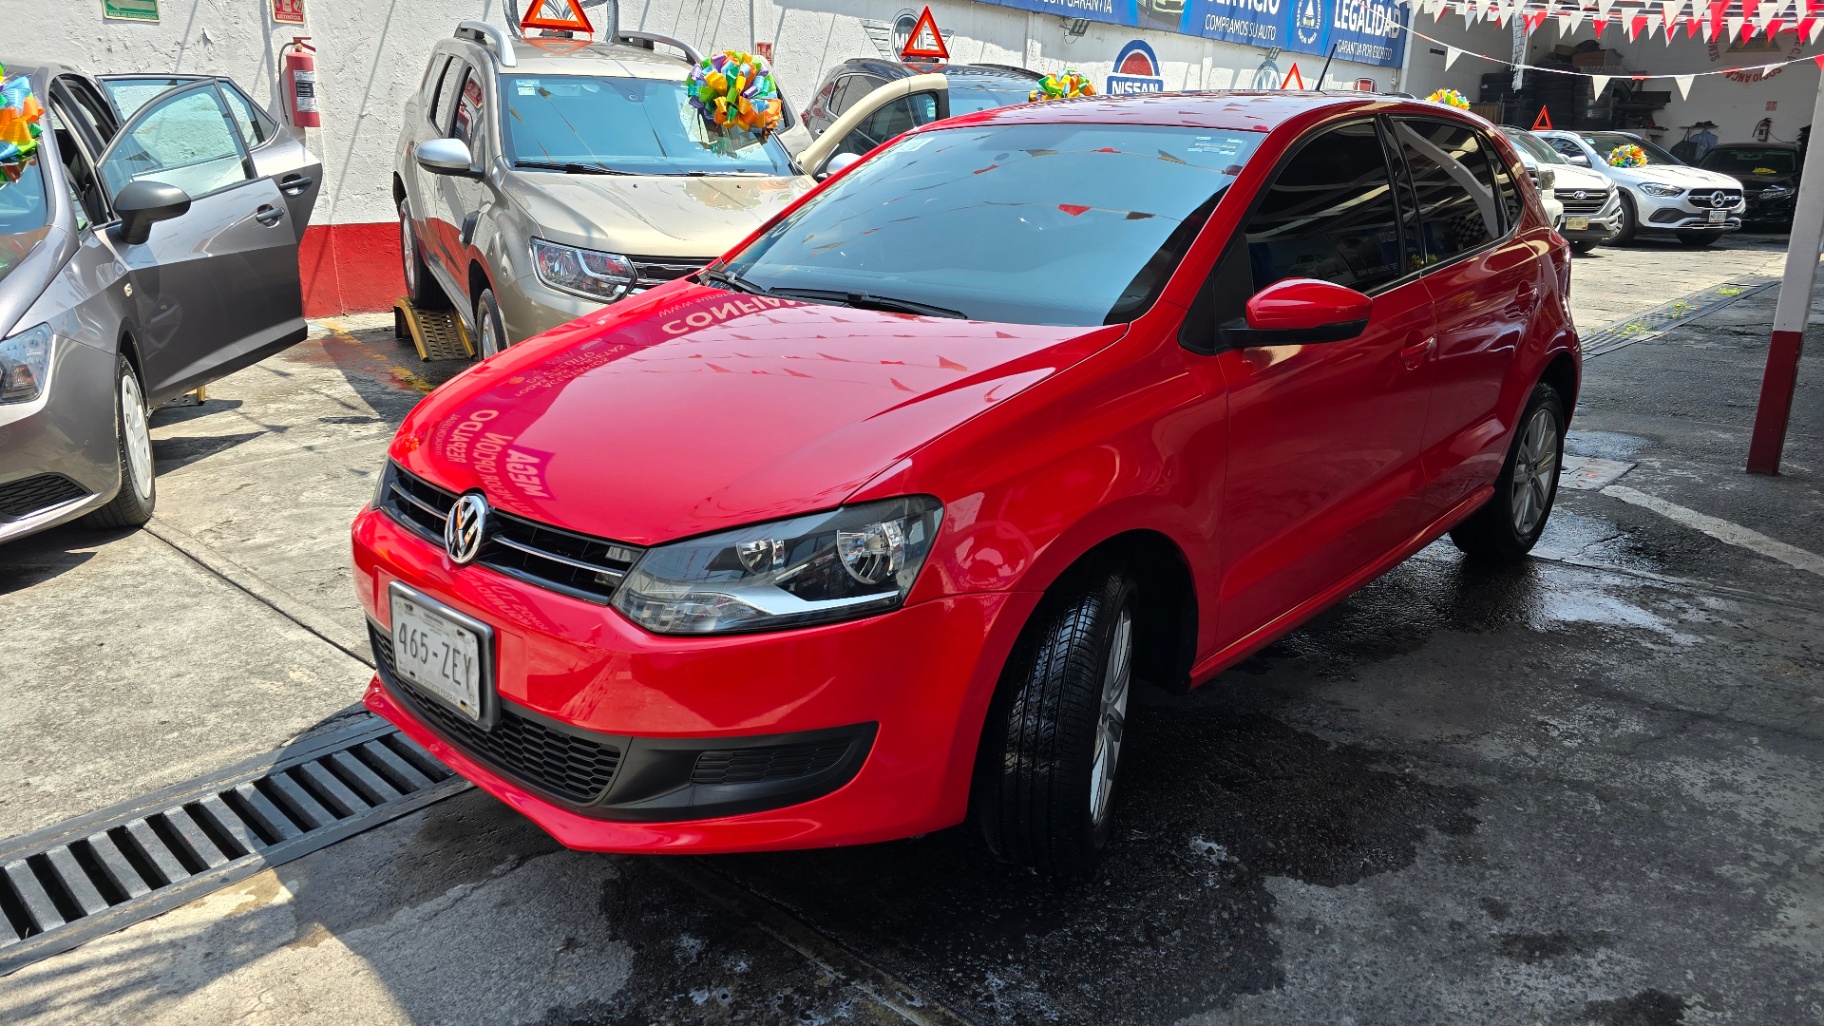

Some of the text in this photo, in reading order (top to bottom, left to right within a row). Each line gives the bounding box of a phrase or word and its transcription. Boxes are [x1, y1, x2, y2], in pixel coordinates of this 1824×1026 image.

[1205, 14, 1276, 40] COMPRAMOS SU AUTO
[1334, 0, 1401, 38] LEGALIDAD
[1362, 43, 1372, 57] POR
[1112, 80, 1159, 94] NISSAN
[399, 622, 471, 691] 465-ZEY
